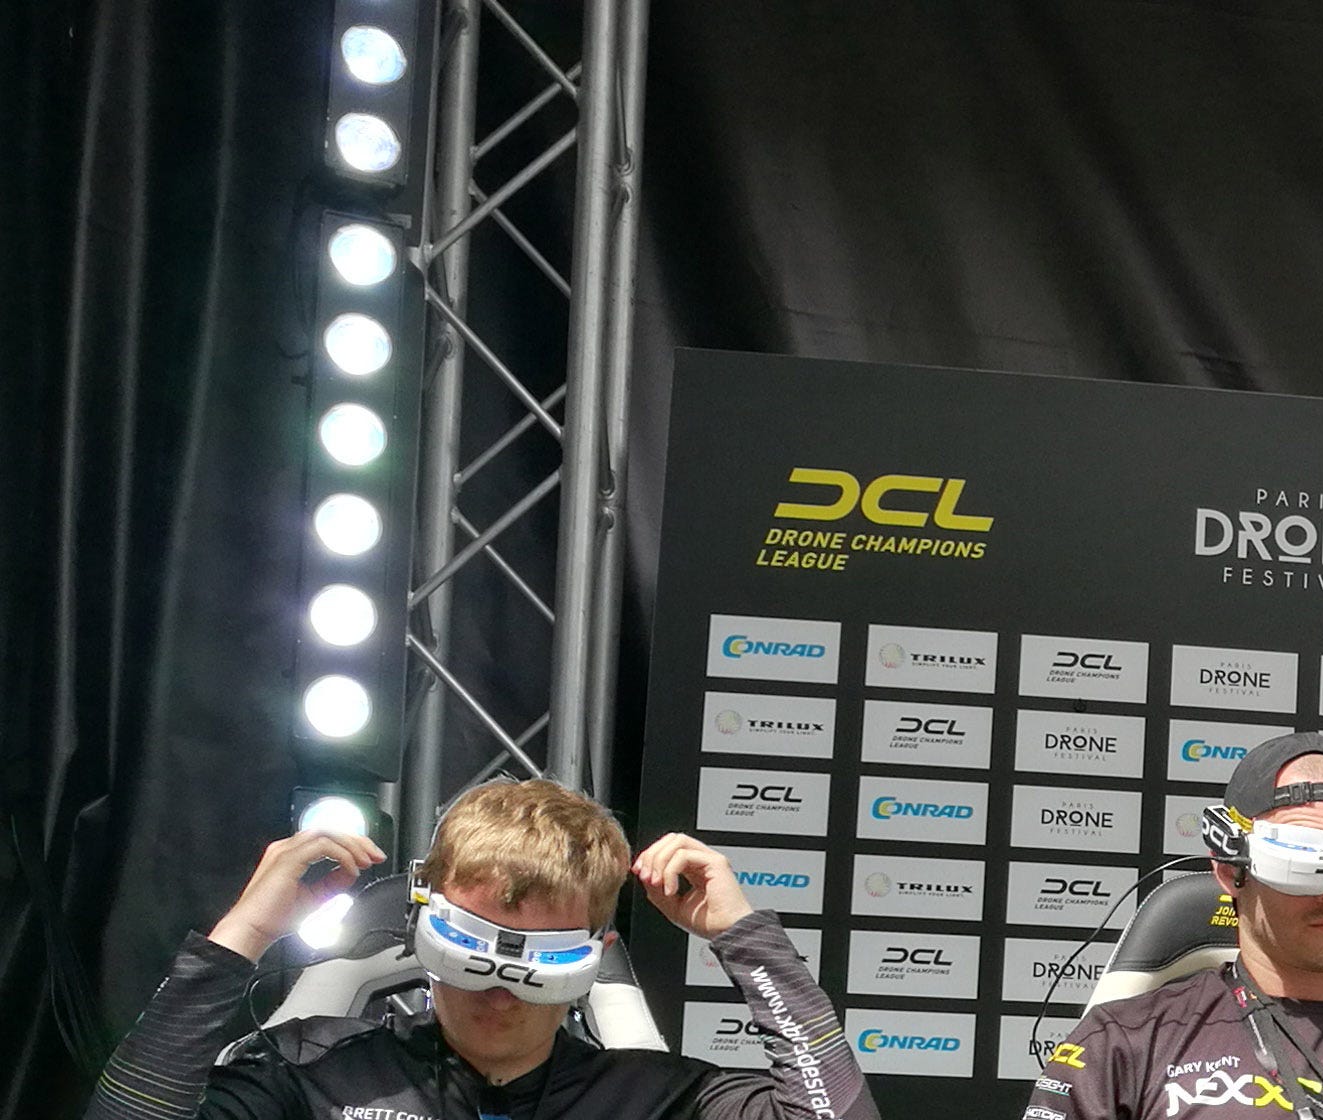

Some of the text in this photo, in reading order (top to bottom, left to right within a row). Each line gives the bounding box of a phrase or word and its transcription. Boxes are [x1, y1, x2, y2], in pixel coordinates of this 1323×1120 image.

[774, 467, 994, 532] DCL
[765, 529, 987, 559] DRONE CHAMPIONS
[756, 549, 849, 571] LEAGUE
[722, 634, 826, 659] CONRAD
[910, 653, 986, 666] TRILUX
[1052, 651, 1122, 671] DCL
[1200, 669, 1271, 689] DRONE
[748, 719, 824, 732] TRILUX
[895, 717, 966, 736] DCL
[1045, 733, 1117, 753] DRONE
[1181, 739, 1247, 762] CONR
[731, 784, 802, 803] DCL
[871, 796, 973, 820] CONRAD
[1041, 809, 1113, 828] DRONE
[897, 882, 973, 894] TRILUX
[1040, 878, 1111, 896] DCL
[881, 947, 953, 966] DCL
[464, 955, 544, 988] DCL
[858, 1029, 960, 1053] CONRAD
[1166, 1055, 1240, 1078] GARY KENT
[342, 1105, 394, 1120] BRETT
